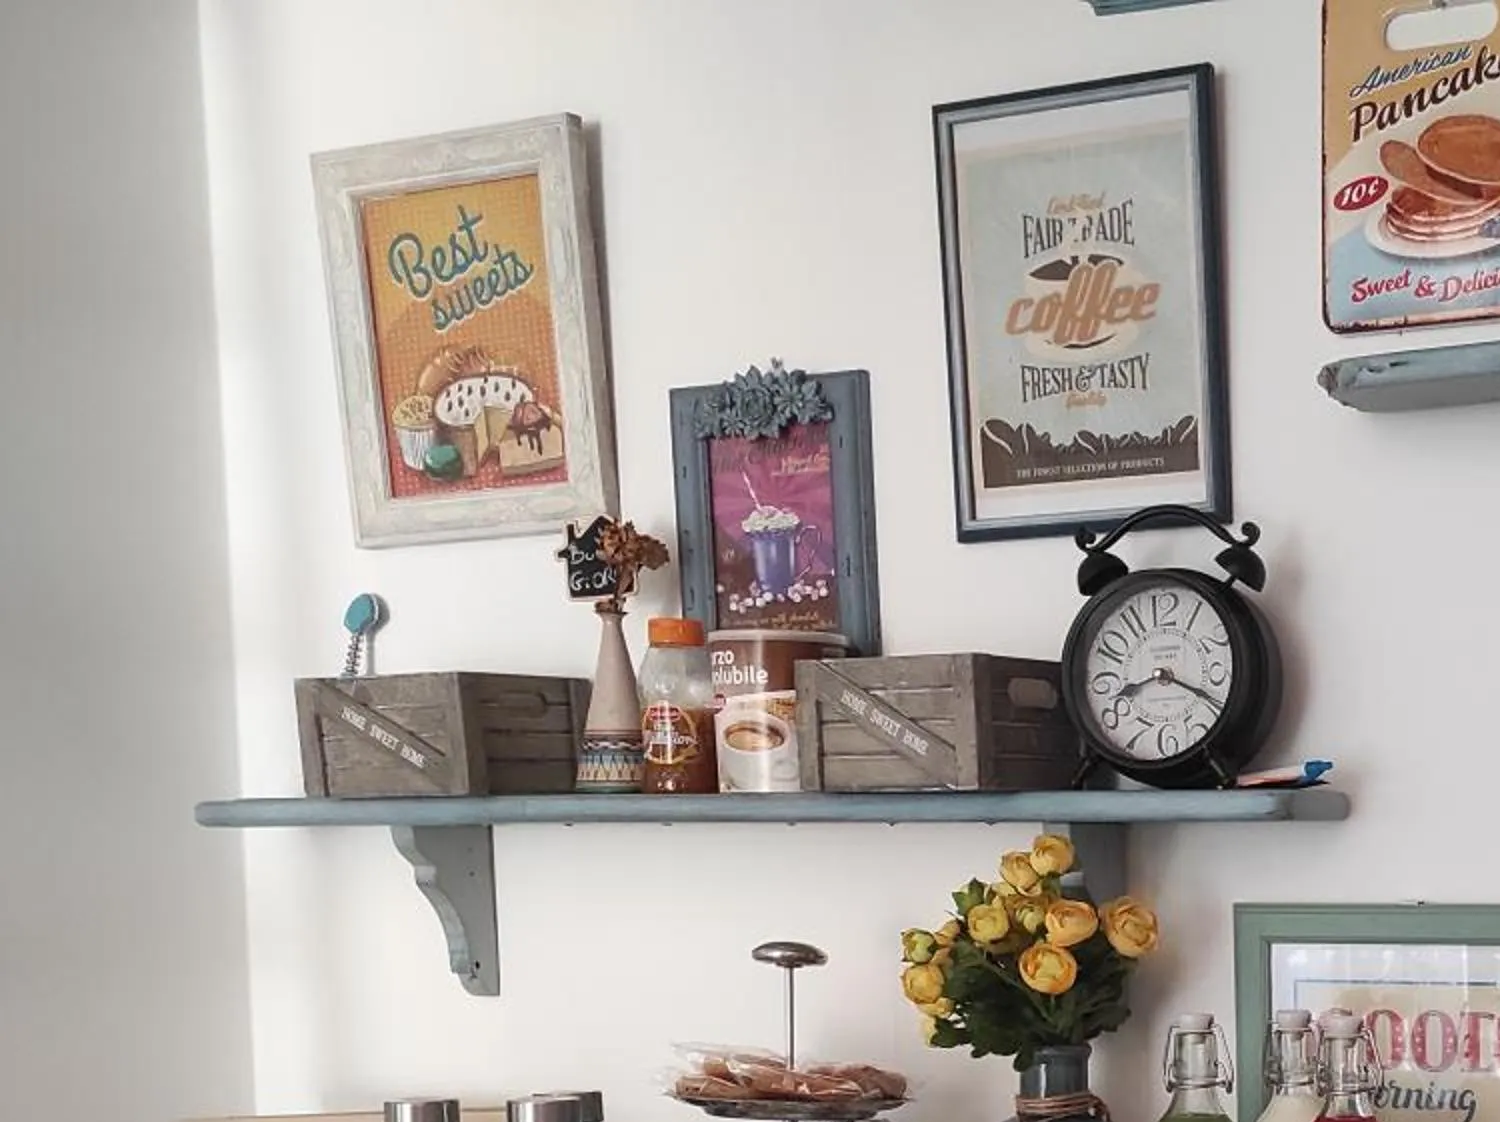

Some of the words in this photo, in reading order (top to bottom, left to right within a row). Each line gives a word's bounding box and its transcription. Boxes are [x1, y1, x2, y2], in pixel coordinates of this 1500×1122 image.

[1350, 45, 1472, 98] American
[388, 204, 488, 298] Best
[1022, 213, 1063, 258] FAIR
[432, 243, 534, 331] sweets
[1005, 260, 1161, 345] coffee
[1352, 268, 1412, 303] Sweet
[1414, 275, 1436, 298] &
[1020, 364, 1073, 402] FRESH
[1075, 363, 1097, 392] &
[1098, 352, 1149, 390] TASTY
[1119, 603, 1148, 639] 11
[1152, 591, 1180, 628] 12
[1186, 600, 1203, 631] 1
[1096, 628, 1130, 665] 10
[1198, 622, 1230, 654] 2
[1091, 670, 1123, 695] 9
[341, 706, 367, 731] HOME
[369, 724, 400, 751] SWEET
[869, 708, 902, 738] SWEET
[1101, 696, 1131, 730] 8
[1124, 716, 1155, 750] 7
[1157, 723, 1180, 758] 6
